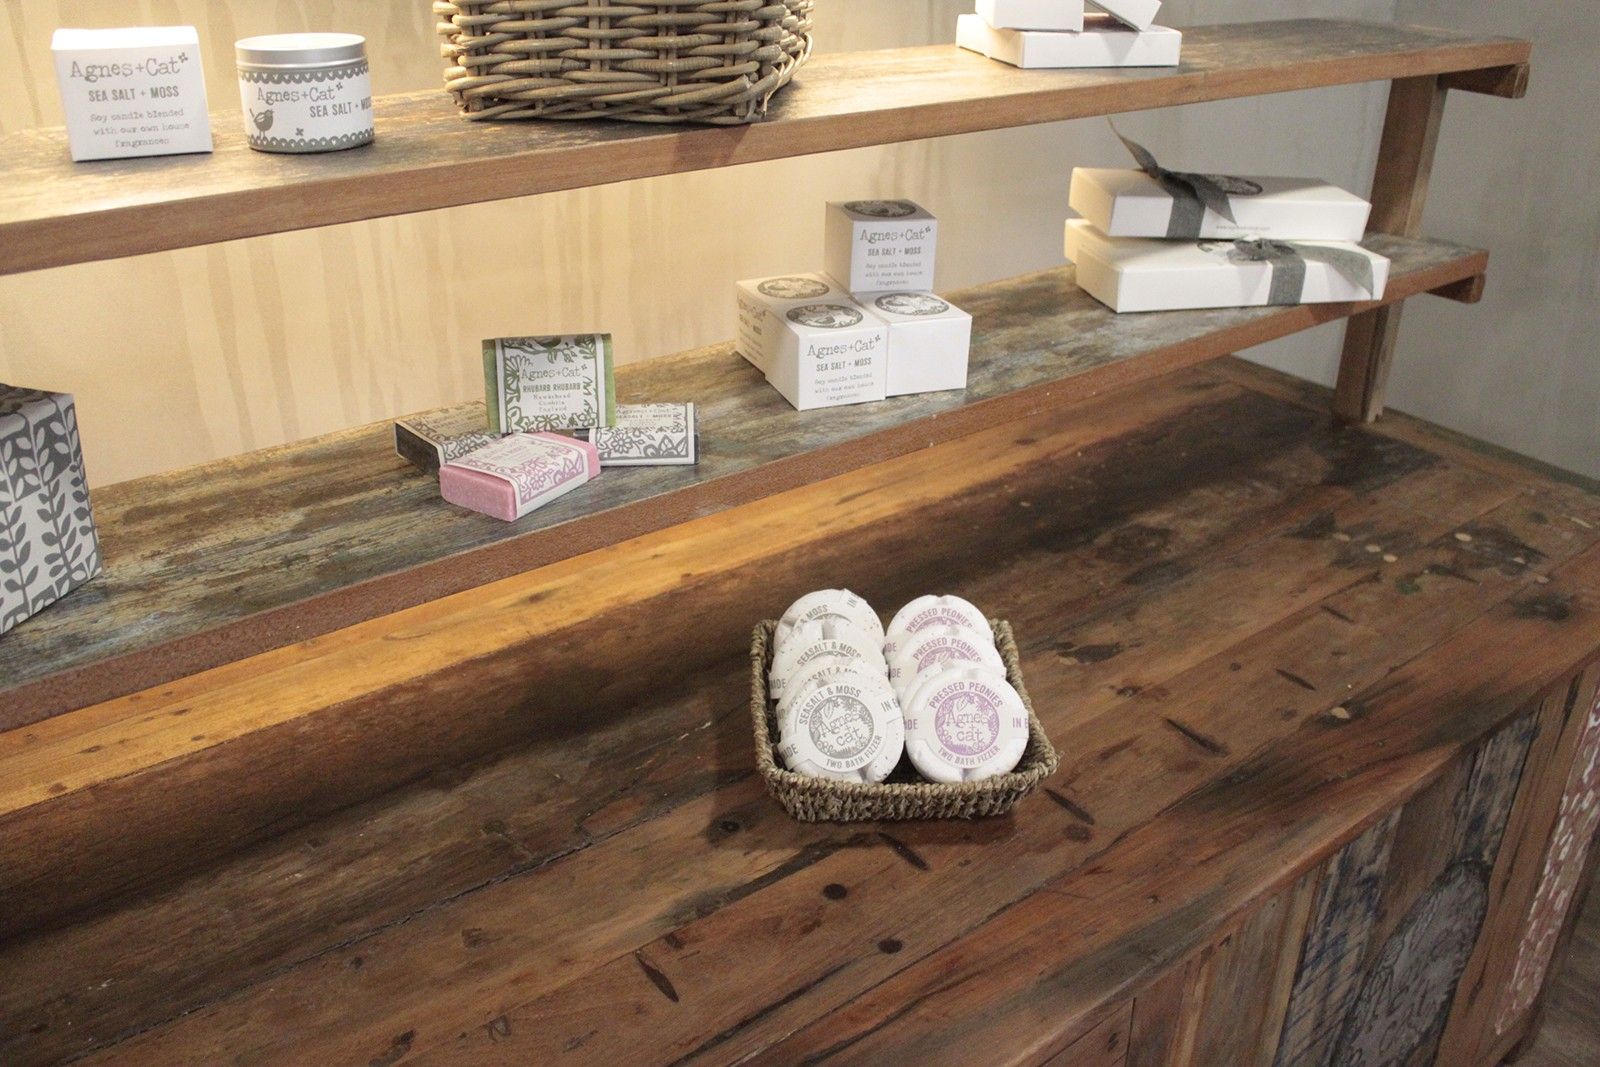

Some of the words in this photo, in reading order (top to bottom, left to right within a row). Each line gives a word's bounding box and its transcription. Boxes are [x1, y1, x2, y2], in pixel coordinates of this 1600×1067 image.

[88, 90, 109, 102] SEA
[112, 88, 136, 101] SALT
[150, 85, 180, 99] MOSS
[147, 108, 184, 119] blended
[309, 105, 329, 118] SEA
[332, 101, 353, 116] SALT
[93, 125, 117, 135] with
[867, 248, 880, 256] SEA
[881, 247, 897, 256] SALT
[904, 246, 922, 255] MOSS
[816, 363, 829, 372] SEA
[830, 361, 846, 371] SALT
[854, 357, 872, 367] MOSS
[523, 384, 551, 392] RHUBARB
[552, 383, 581, 391] RHUBARB
[806, 604, 829, 618] MOSS
[906, 608, 938, 633] PRESSED
[797, 641, 828, 667] SEASALT
[913, 637, 947, 660] PRESSED
[929, 681, 965, 709] PRESSED
[969, 681, 1003, 708] PEONIES
[800, 691, 825, 725] SEASALT
[827, 687, 834, 696] &
[836, 685, 861, 697] MOSS
[880, 700, 892, 712] IN
[945, 710, 989, 729] Agnes
[1012, 717, 1022, 729] IN
[836, 727, 863, 746] cat
[956, 728, 983, 742] cat
[826, 759, 843, 768] TWO
[845, 757, 865, 768] BATH
[865, 735, 883, 759] FIZZER
[938, 746, 953, 761] TWO
[955, 757, 976, 766] BATH
[977, 745, 1000, 763] FIZZER
